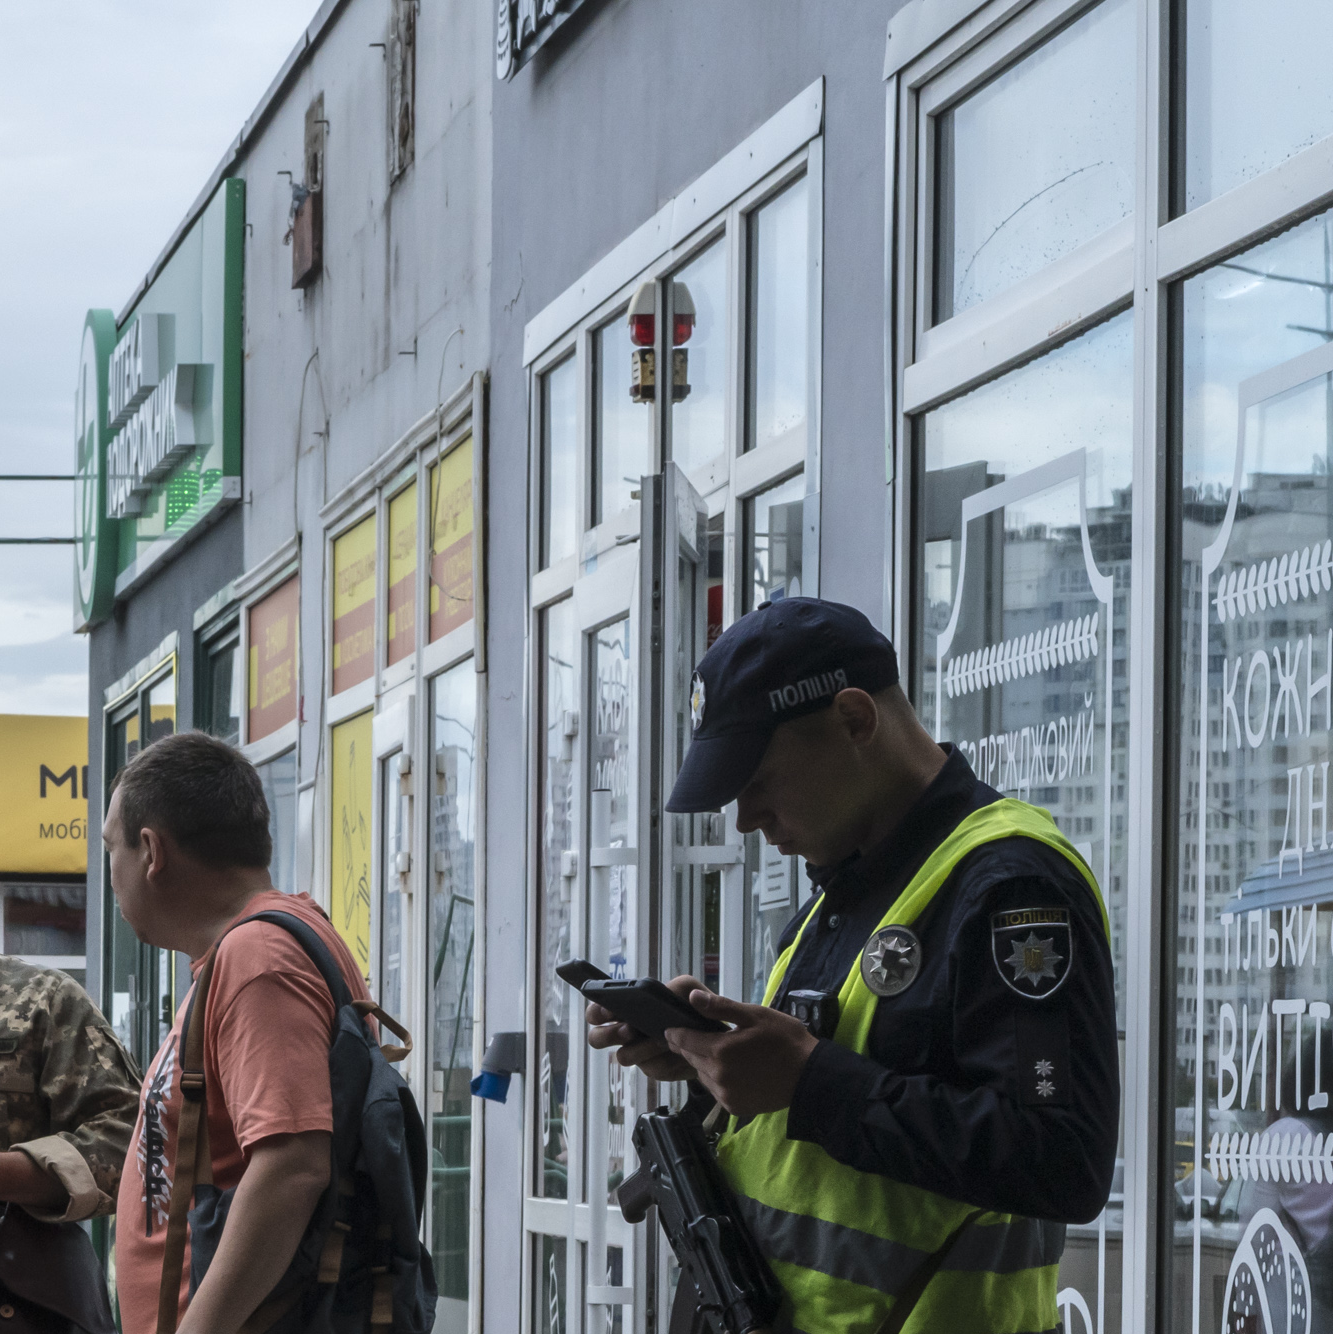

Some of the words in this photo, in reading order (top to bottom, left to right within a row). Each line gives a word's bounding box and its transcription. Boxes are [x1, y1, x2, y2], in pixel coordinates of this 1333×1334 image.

[768, 668, 849, 712] ПОЛІЦІЯ
[1223, 628, 1333, 752] КОЖН
[1279, 761, 1333, 879] ДН
[998, 911, 1063, 926] ПОЛІЦІЯ
[1220, 888, 1318, 974] ТІЛЬКИ
[1217, 999, 1331, 1112] ВИПІ
